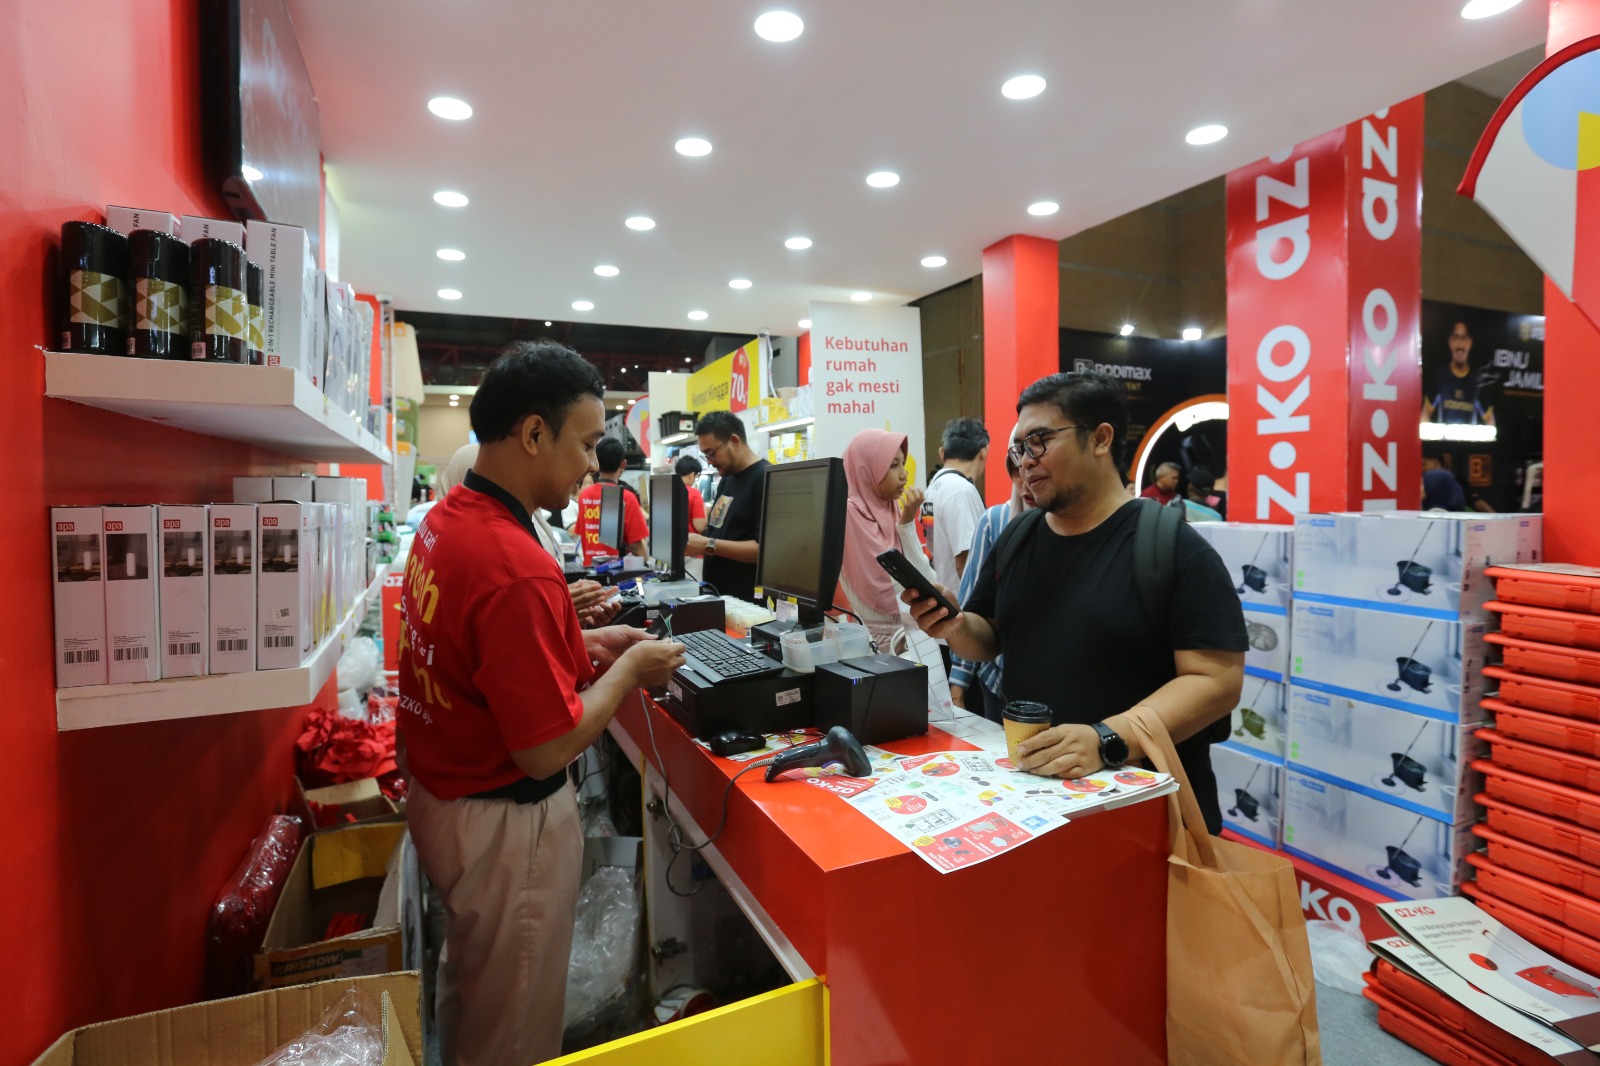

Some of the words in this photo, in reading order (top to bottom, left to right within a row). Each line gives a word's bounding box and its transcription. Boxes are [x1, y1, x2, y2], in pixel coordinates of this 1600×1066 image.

[268, 282, 276, 333] RECHARGEABLE
[825, 336, 908, 352] Kebutuhan
[826, 358, 877, 372] rumah
[1494, 349, 1530, 370] IBNU
[826, 378, 854, 396] gak
[859, 379, 900, 393] mesti
[827, 399, 875, 414] mahal
[57, 522, 74, 532] apa
[105, 521, 123, 531] apa
[164, 519, 180, 529] apa
[215, 517, 231, 527] apa
[263, 516, 279, 526] apa
[274, 953, 341, 975] KRISBOW
